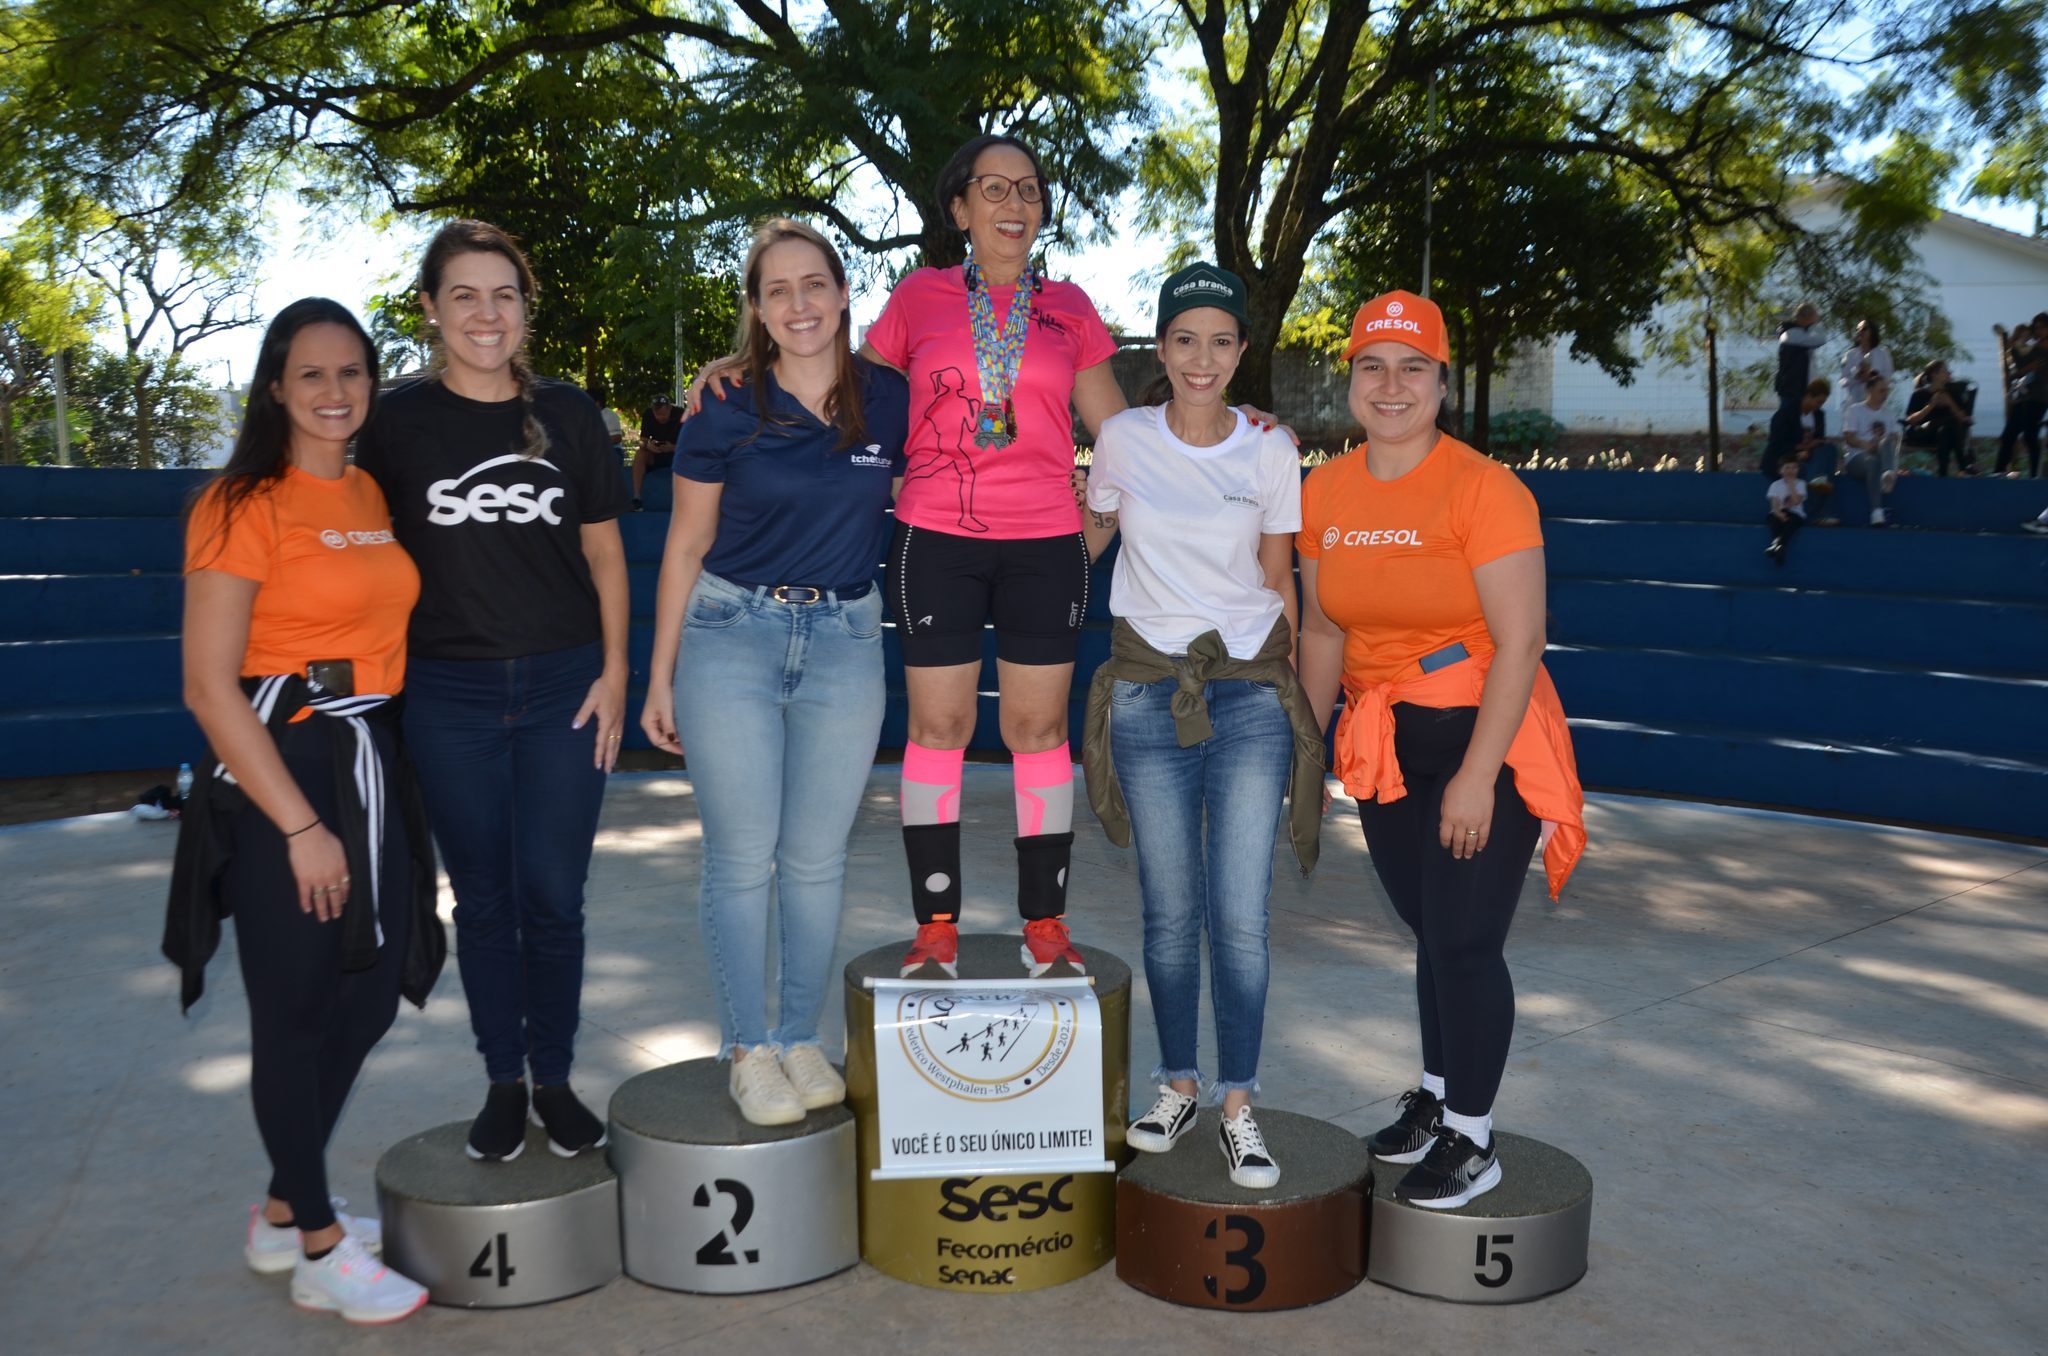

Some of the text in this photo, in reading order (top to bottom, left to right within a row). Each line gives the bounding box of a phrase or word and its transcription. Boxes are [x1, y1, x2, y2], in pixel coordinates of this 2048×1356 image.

[1173, 279, 1233, 296] Casa Branca
[1366, 318, 1422, 335] CRESOL
[426, 476, 565, 526] Sesc
[1343, 529, 1423, 546] CRESOL
[1036, 1047, 1063, 1077] Desde
[892, 1129, 1093, 1155] VOCÊ É O SEU ÚNICO LIMITE!
[937, 1175, 1074, 1222] Sesc
[692, 1178, 760, 1265] 2
[468, 1232, 516, 1287] 4
[936, 1231, 1074, 1260] Fecomércio
[1203, 1214, 1267, 1304] 3
[938, 1265, 1015, 1285] Senac
[1473, 1234, 1514, 1288] 5
